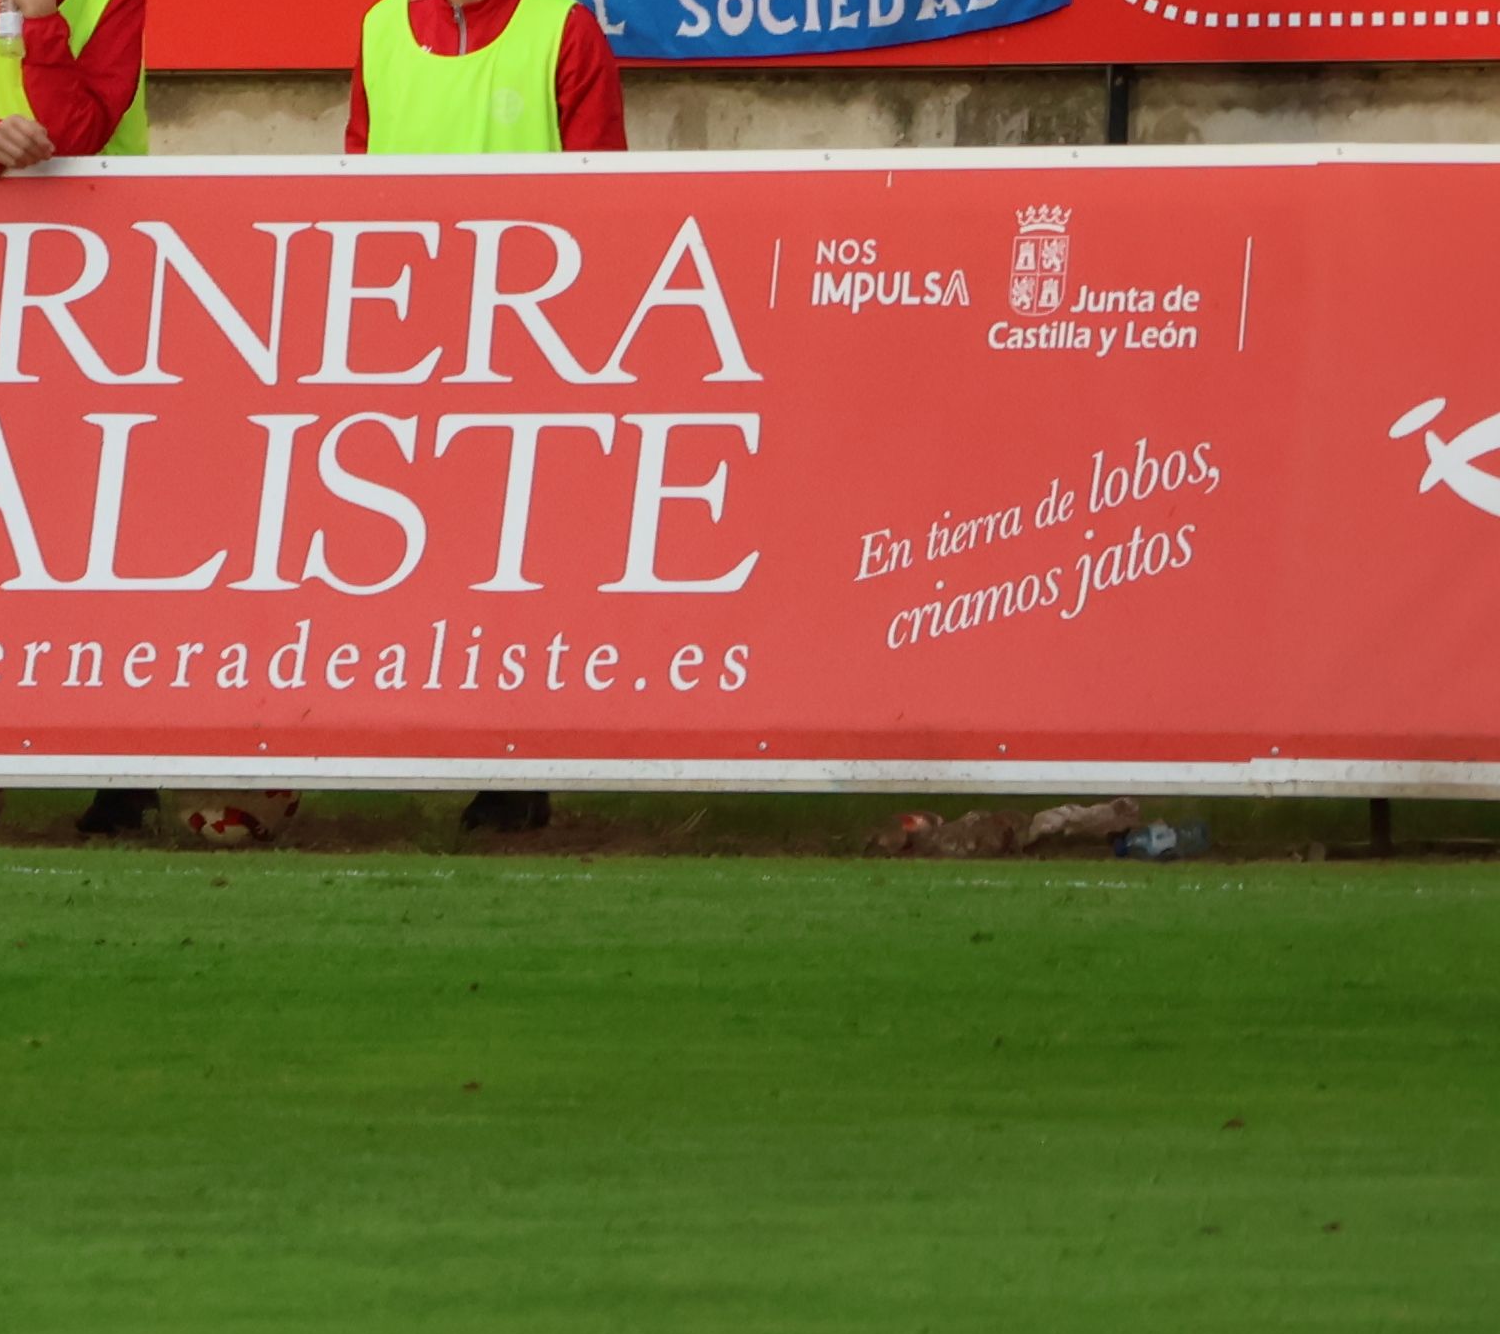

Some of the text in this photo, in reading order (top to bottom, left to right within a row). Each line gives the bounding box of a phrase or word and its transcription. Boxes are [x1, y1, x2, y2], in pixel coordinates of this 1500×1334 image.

[815, 238, 878, 265] NOS
[1070, 283, 1201, 314] Junta de
[987, 320, 1199, 358] Castilla y León
[852, 437, 1221, 582] En tierra de lobos,
[885, 521, 1197, 650] criamos jatos
